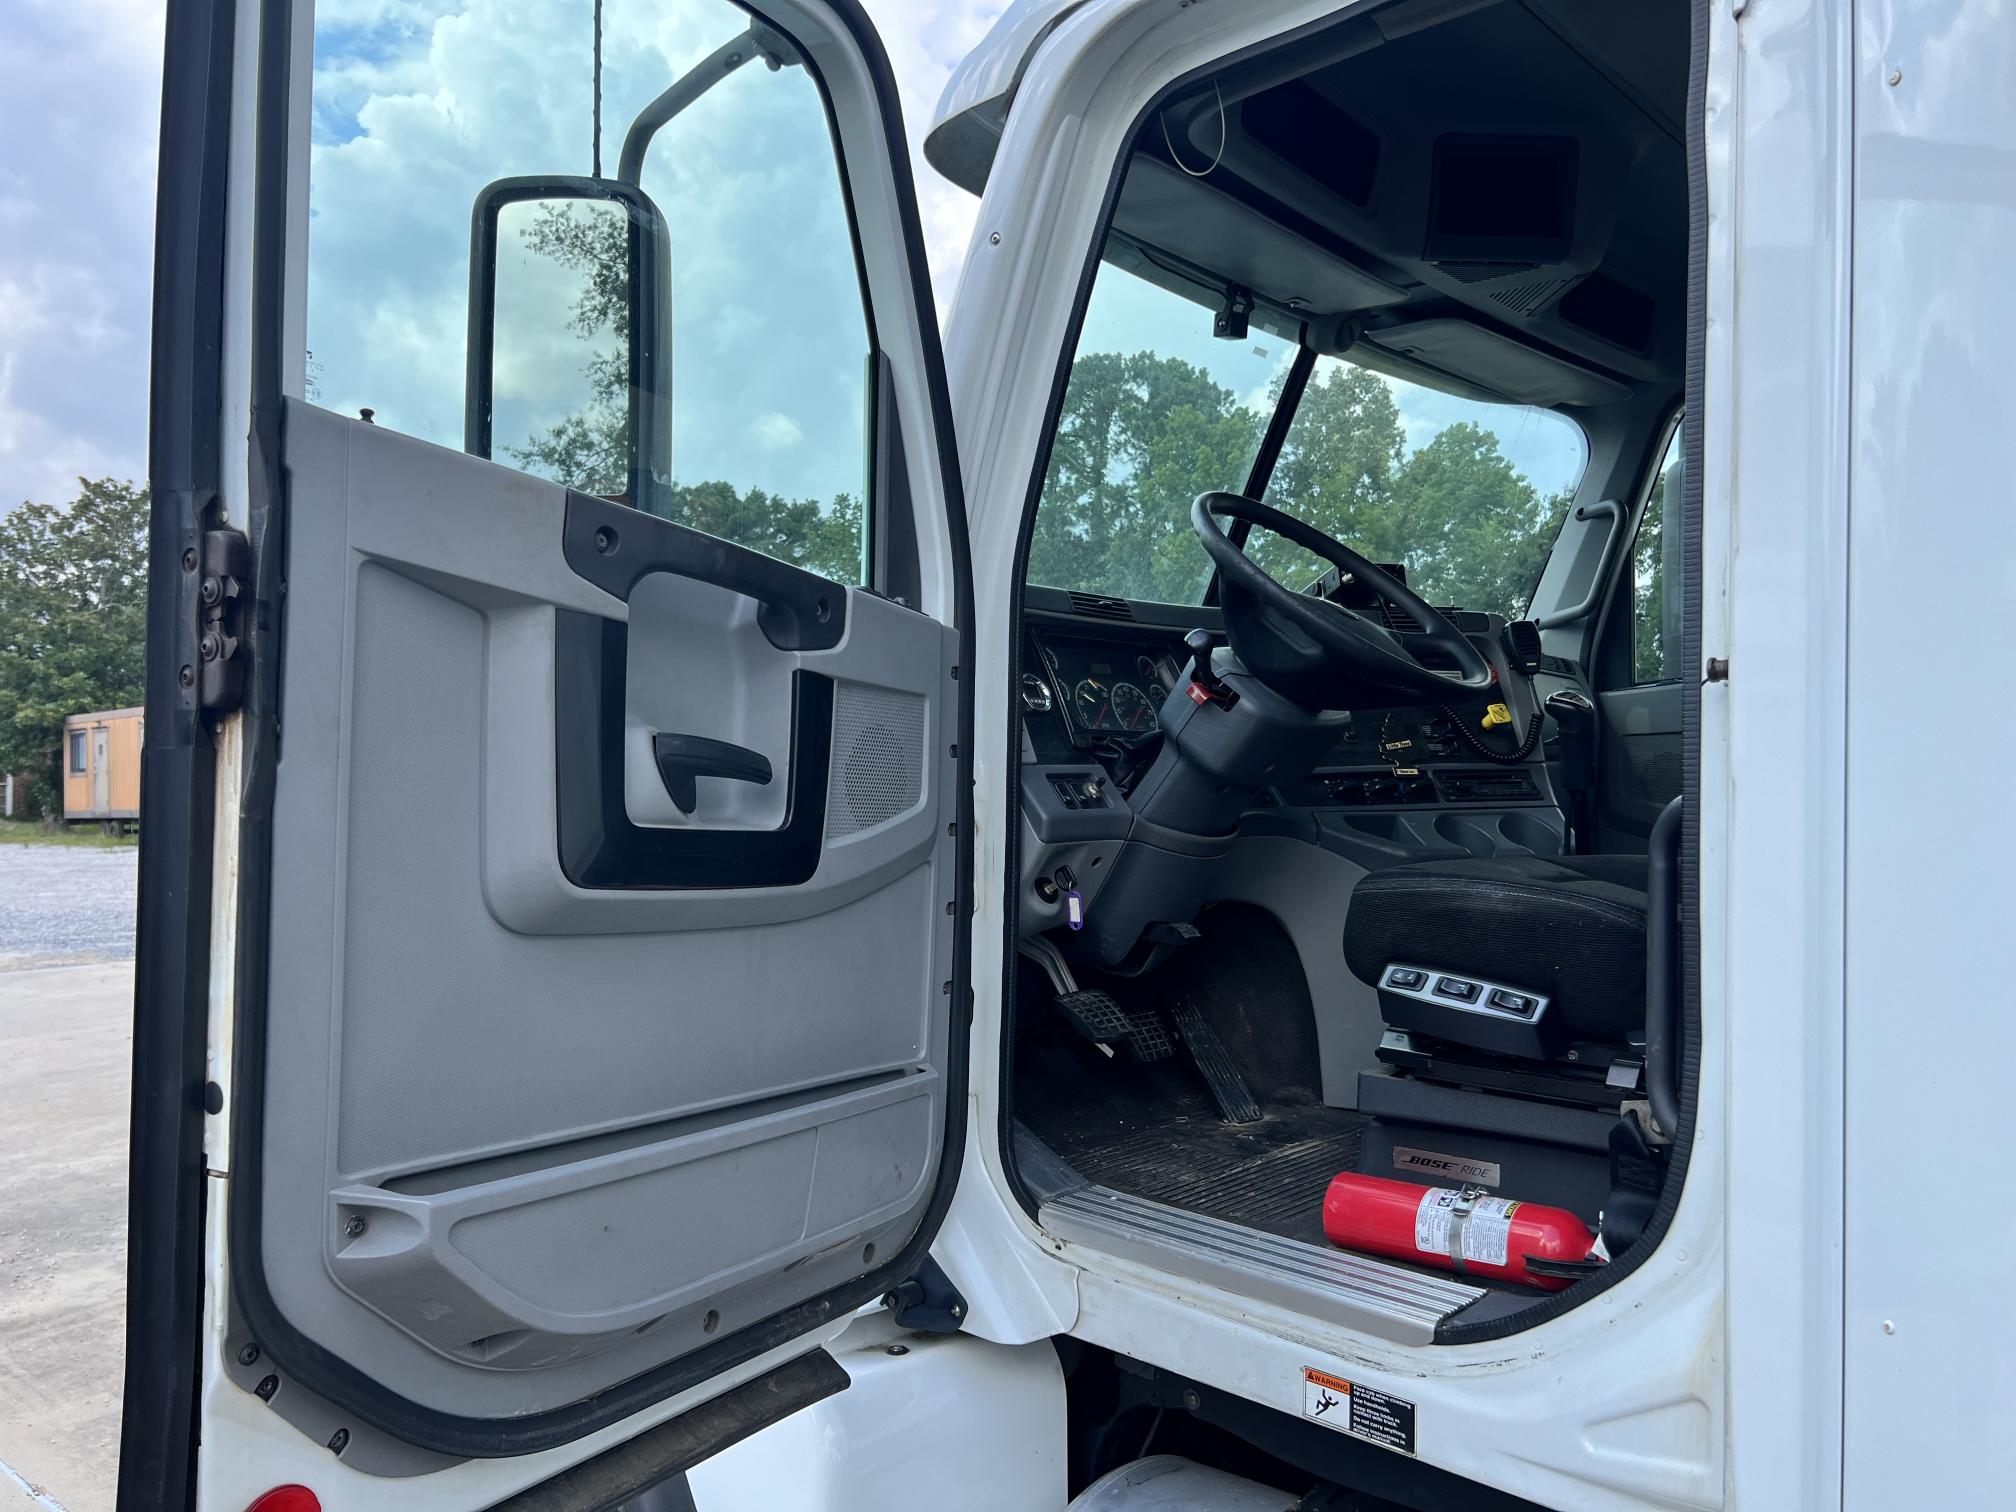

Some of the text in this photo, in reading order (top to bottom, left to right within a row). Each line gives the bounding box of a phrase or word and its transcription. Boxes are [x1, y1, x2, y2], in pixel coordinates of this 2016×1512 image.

[1402, 1156, 1492, 1178] BOSE RIDE
[1313, 1374, 1348, 1392] WARNING
[1354, 1404, 1366, 1412] Keep
[1390, 1397, 1411, 1409] climbing
[1353, 1423, 1369, 1432] Follow
[1370, 1428, 1399, 1443] instructions
[1370, 1422, 1383, 1430] carry
